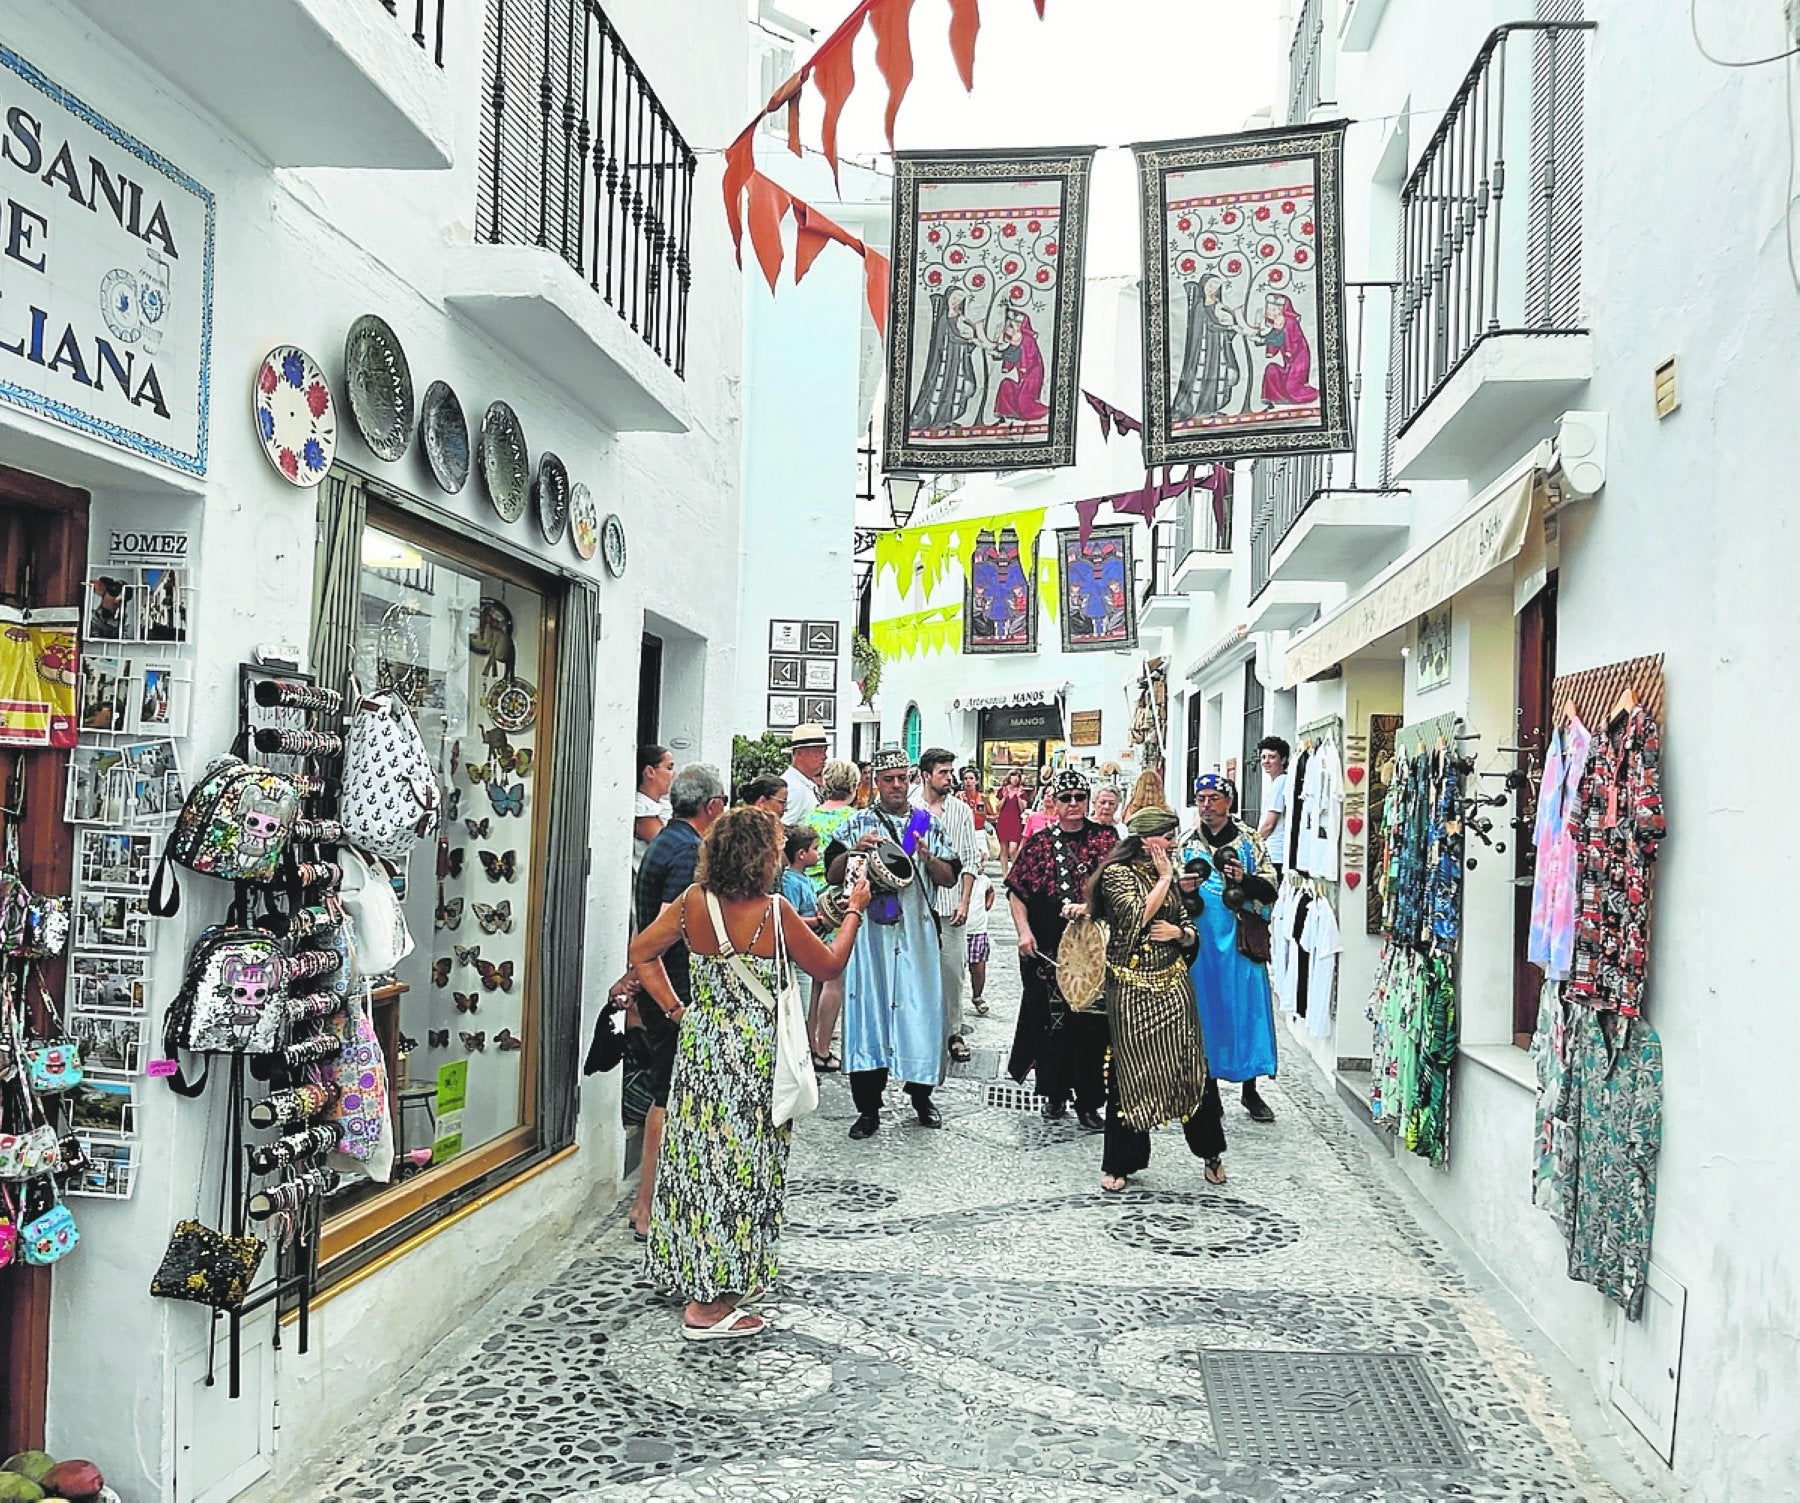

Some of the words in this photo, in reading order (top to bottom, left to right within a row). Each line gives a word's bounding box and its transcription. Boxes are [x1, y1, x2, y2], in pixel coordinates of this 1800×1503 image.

[2, 106, 178, 260] SANIA
[0, 198, 48, 274] E
[1012, 690, 1045, 703] MANOS
[1010, 716, 1045, 727] MANOS
